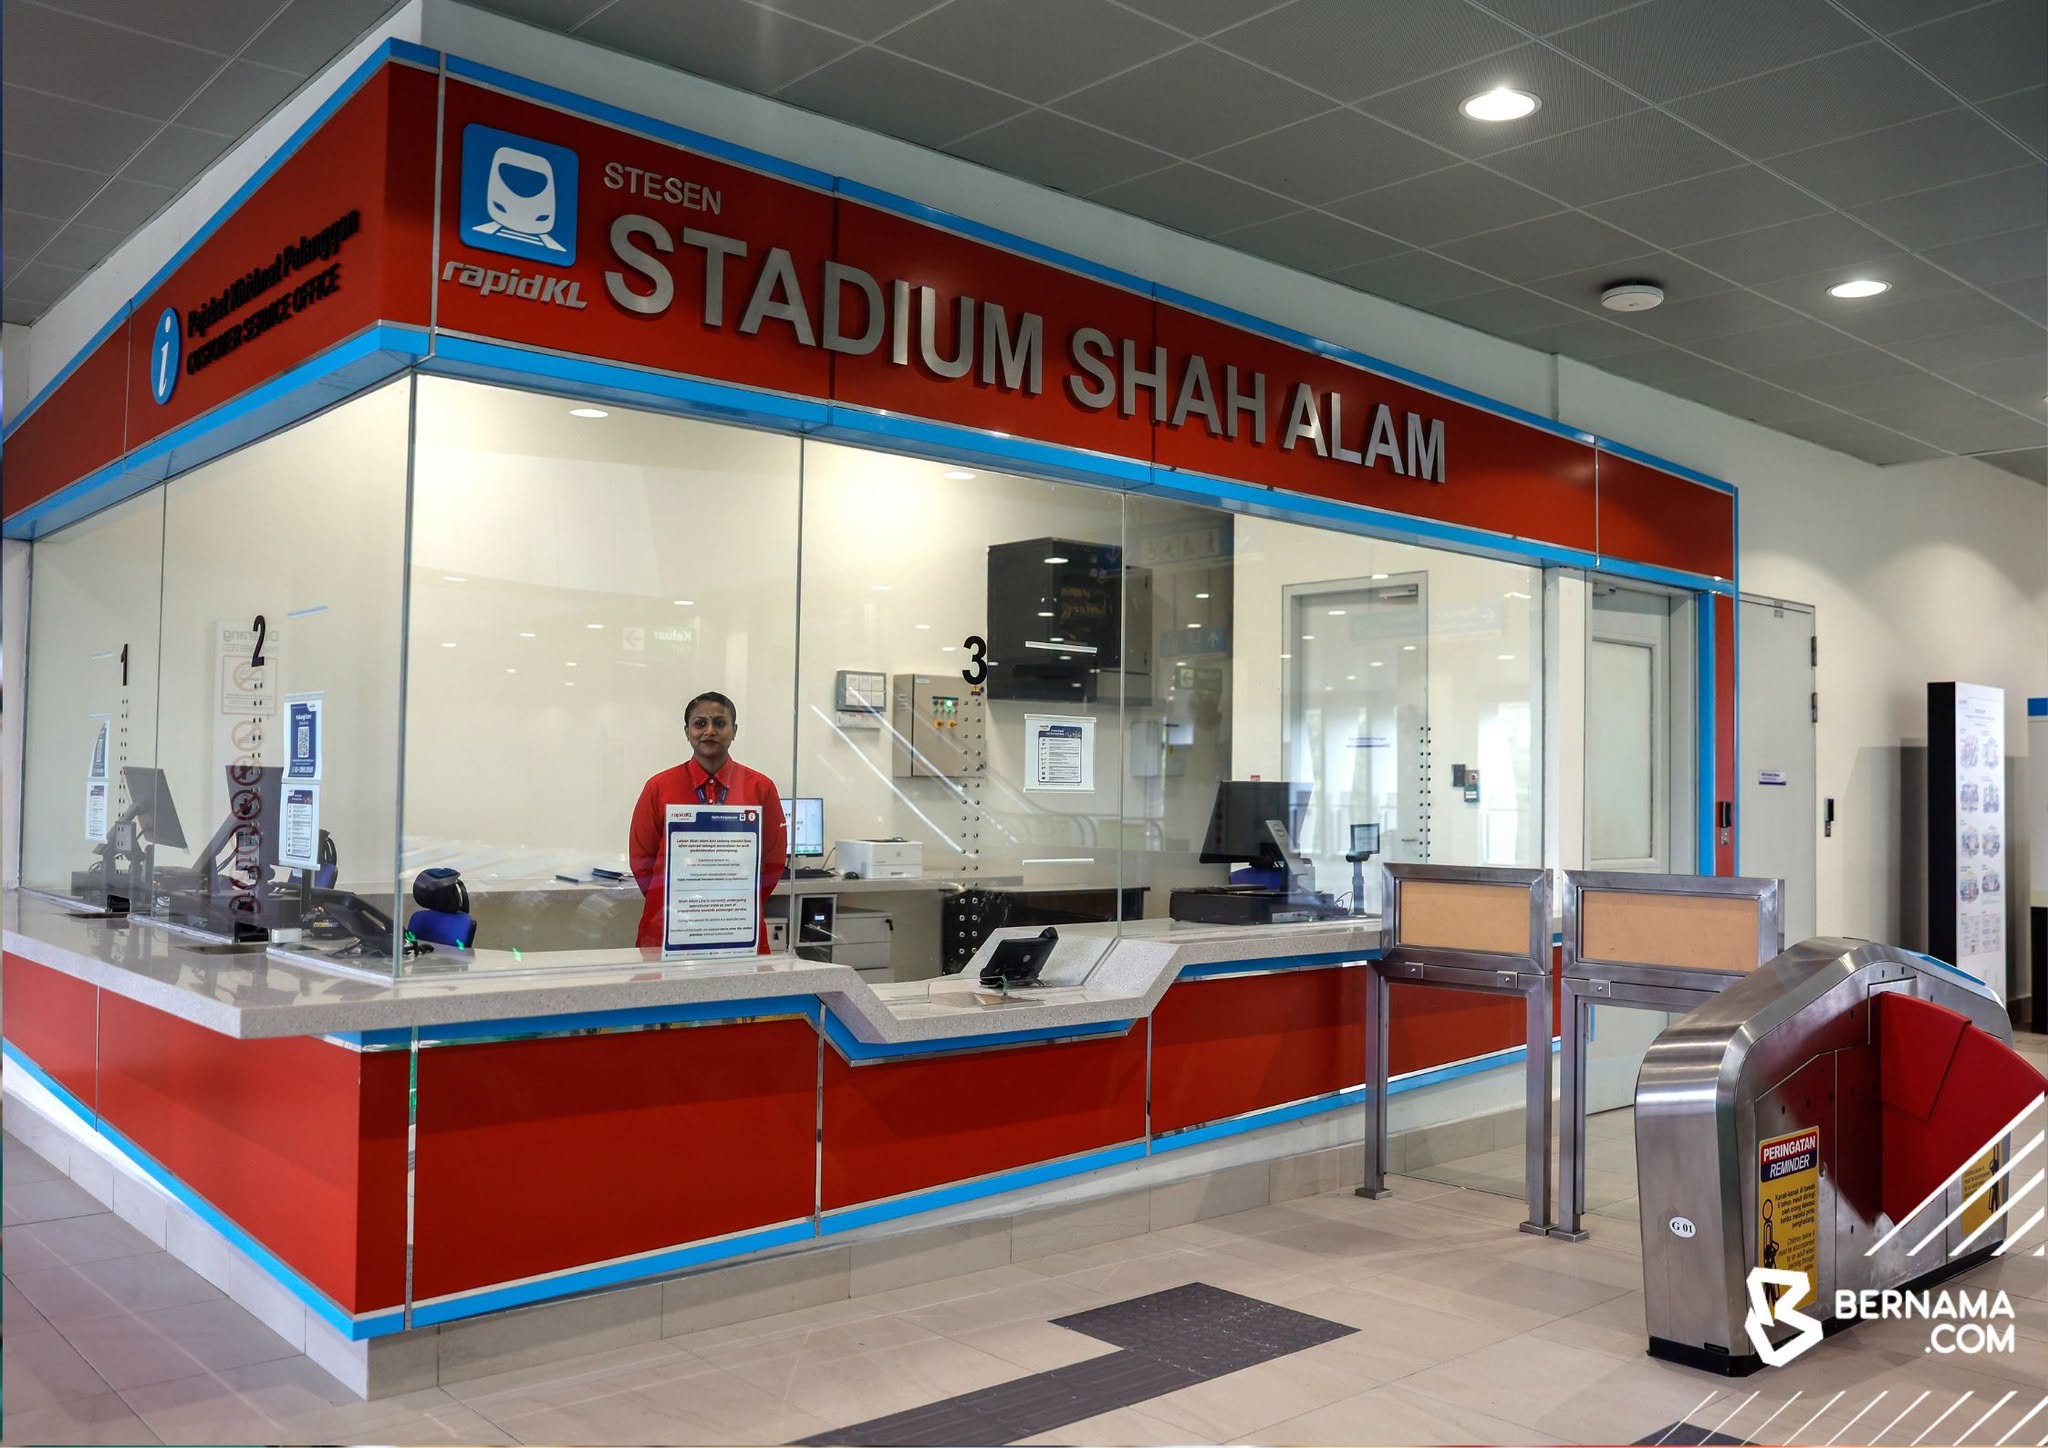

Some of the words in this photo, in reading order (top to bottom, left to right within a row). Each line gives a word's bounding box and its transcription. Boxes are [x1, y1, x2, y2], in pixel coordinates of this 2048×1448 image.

[603, 162, 722, 215] STESEN
[283, 209, 360, 278] Pelanggan
[243, 292, 292, 339] SERVICE
[292, 262, 342, 313] OFFICE
[442, 260, 588, 310] rapidKL
[604, 213, 1044, 396] STADIUM
[1068, 327, 1267, 444] SHAH
[1282, 383, 1447, 485] ALAM
[120, 643, 129, 687] 1
[251, 614, 266, 667] 2
[961, 635, 988, 686] 3
[1763, 1135, 1816, 1162] PERINGATAN
[1770, 1154, 1810, 1178] REMINDER
[1672, 1221, 1680, 1231] G
[1682, 1223, 1693, 1234] 01
